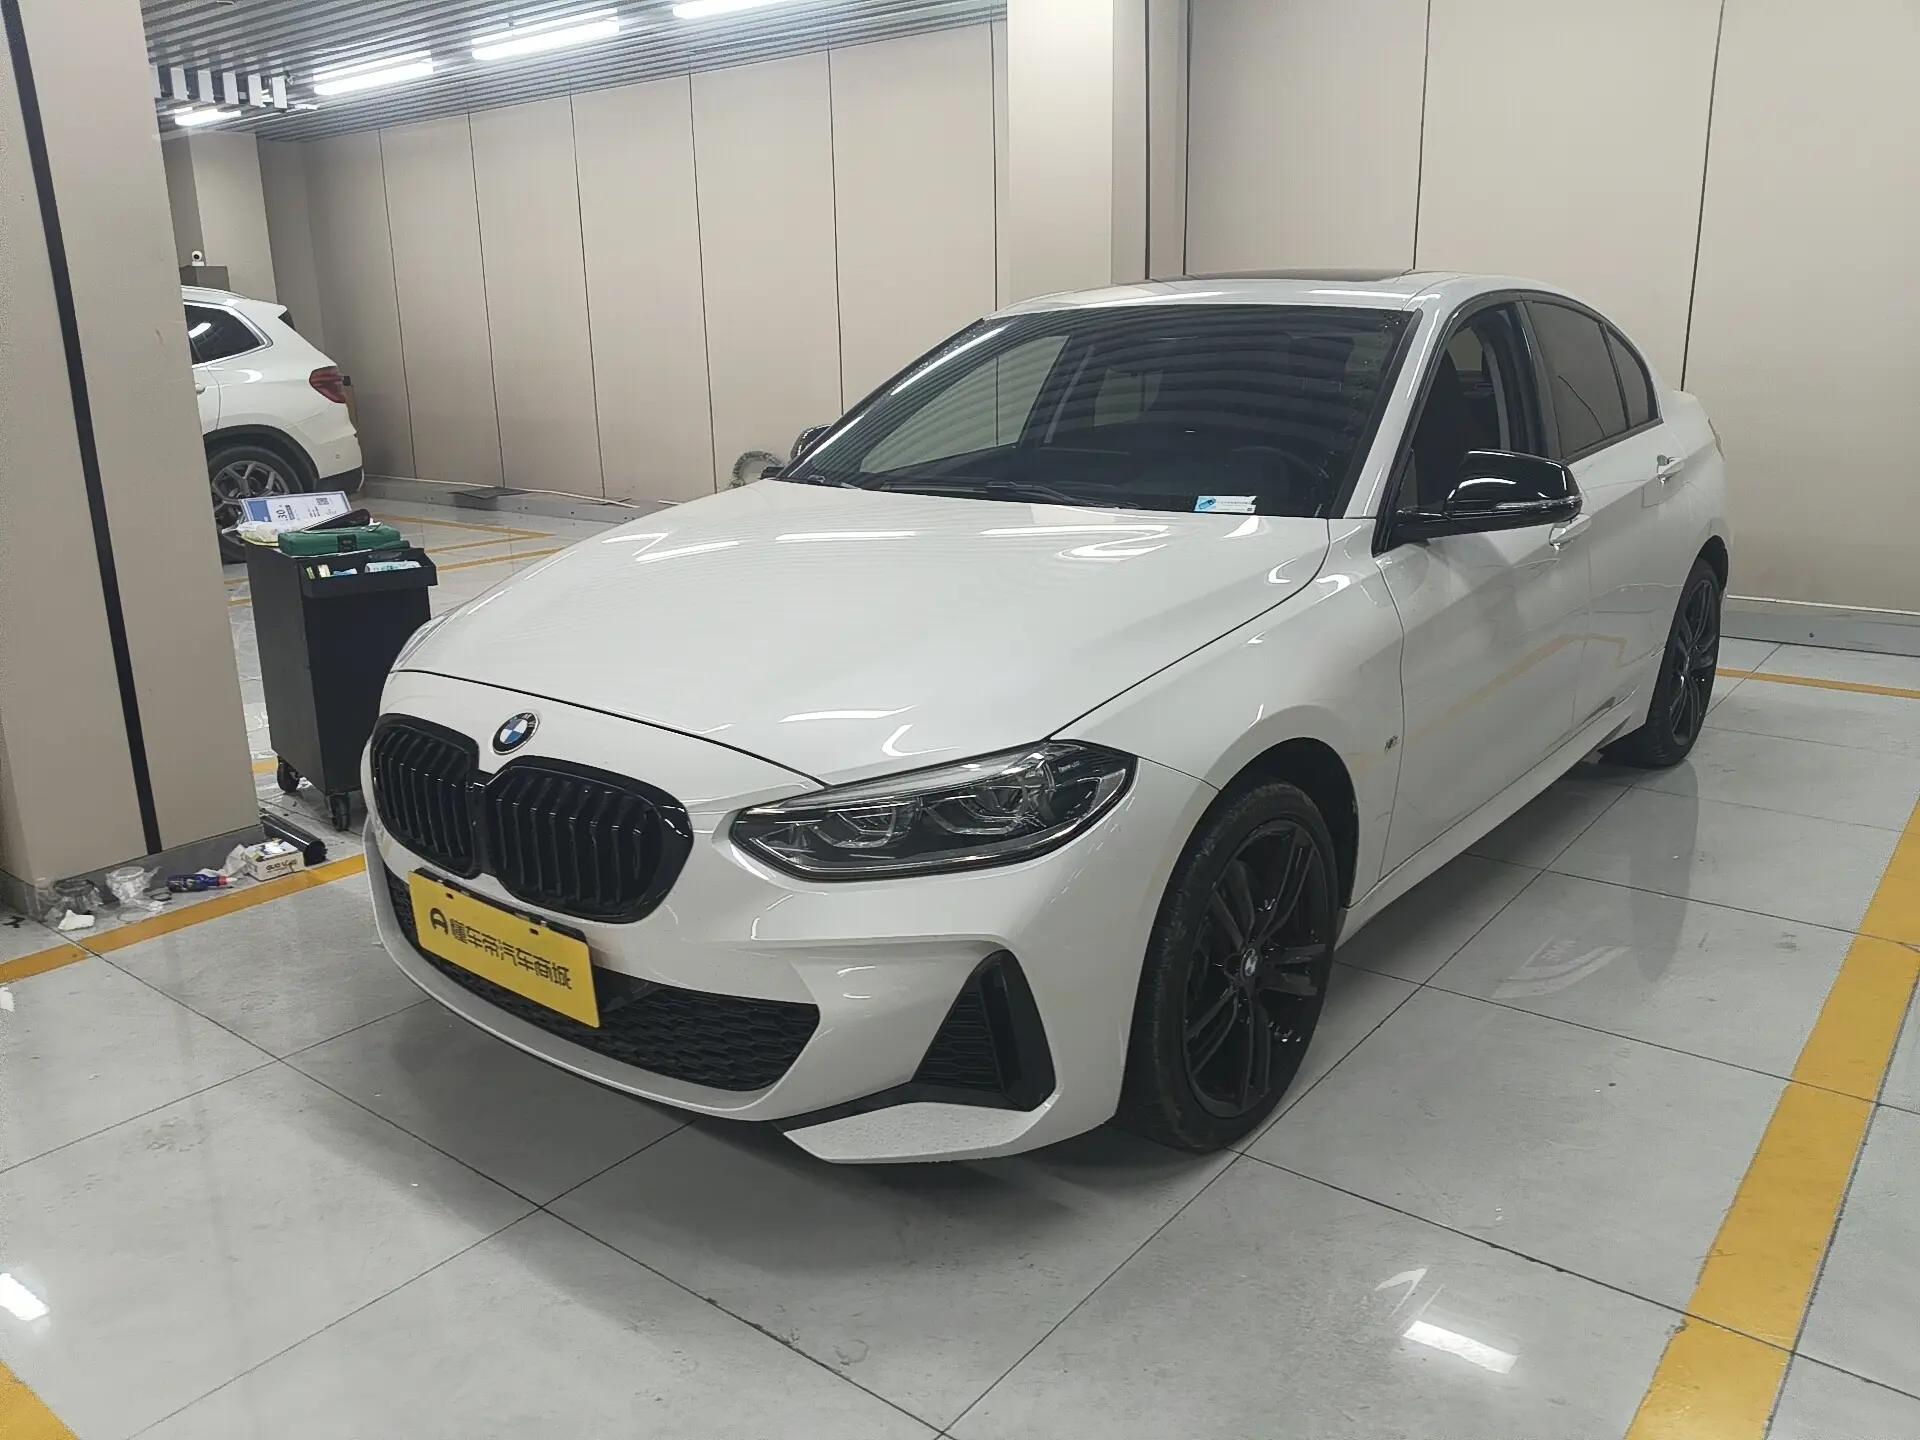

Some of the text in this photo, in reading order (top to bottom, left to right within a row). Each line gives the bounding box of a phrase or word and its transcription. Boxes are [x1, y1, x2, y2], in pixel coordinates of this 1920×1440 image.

[450, 918, 573, 990] 懂车帝汽车商城
